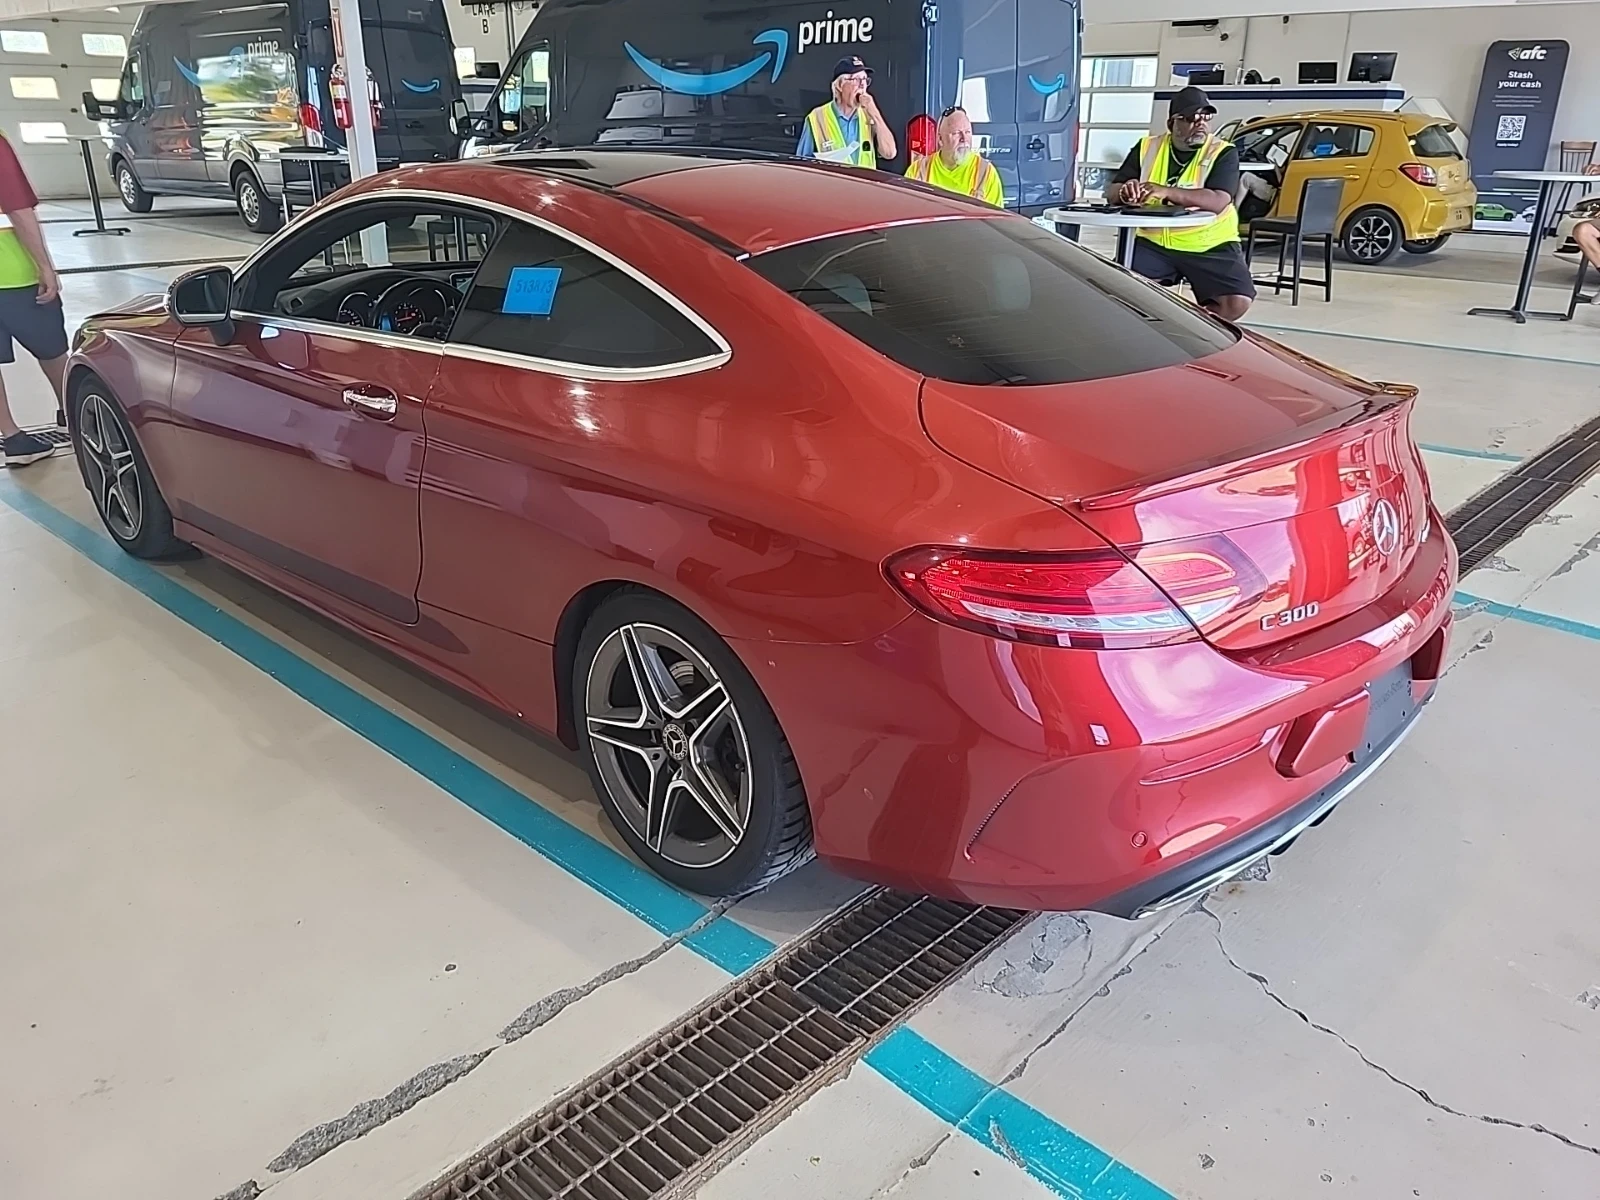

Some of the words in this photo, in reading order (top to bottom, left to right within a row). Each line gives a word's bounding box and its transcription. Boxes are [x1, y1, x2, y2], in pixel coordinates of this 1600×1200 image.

[482, 18, 489, 34] B
[798, 10, 874, 54] prime
[247, 35, 279, 63] prime
[1519, 45, 1547, 60] afc
[1508, 70, 1534, 79] Stash
[1498, 80, 1519, 89] your
[1520, 80, 1542, 88] cash
